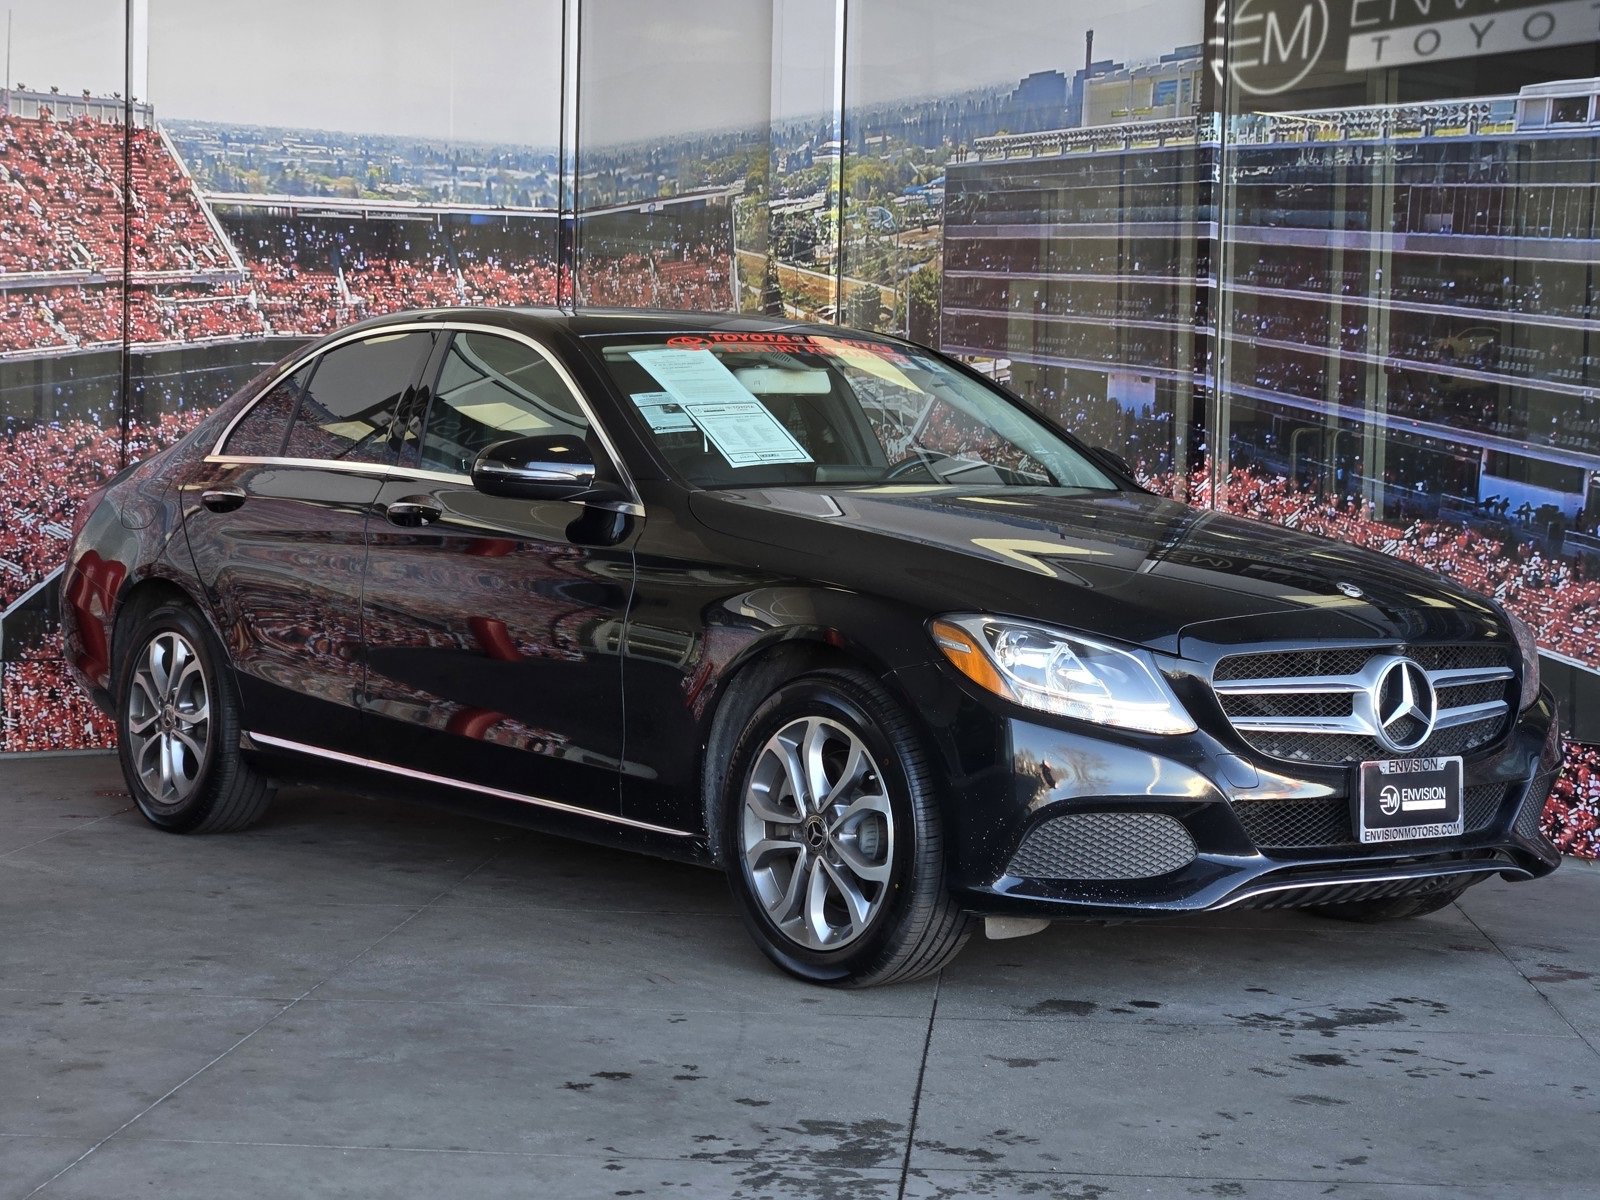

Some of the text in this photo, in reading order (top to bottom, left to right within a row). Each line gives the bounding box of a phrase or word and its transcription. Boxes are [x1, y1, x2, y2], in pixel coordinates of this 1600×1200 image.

[1371, 3, 1600, 62] TOYO
[709, 333, 791, 343] TOYOTA
[1388, 758, 1438, 774] ENVISION
[1402, 786, 1446, 801] ENVISION
[1364, 823, 1460, 842] ENVISIONMOTORS.COM
